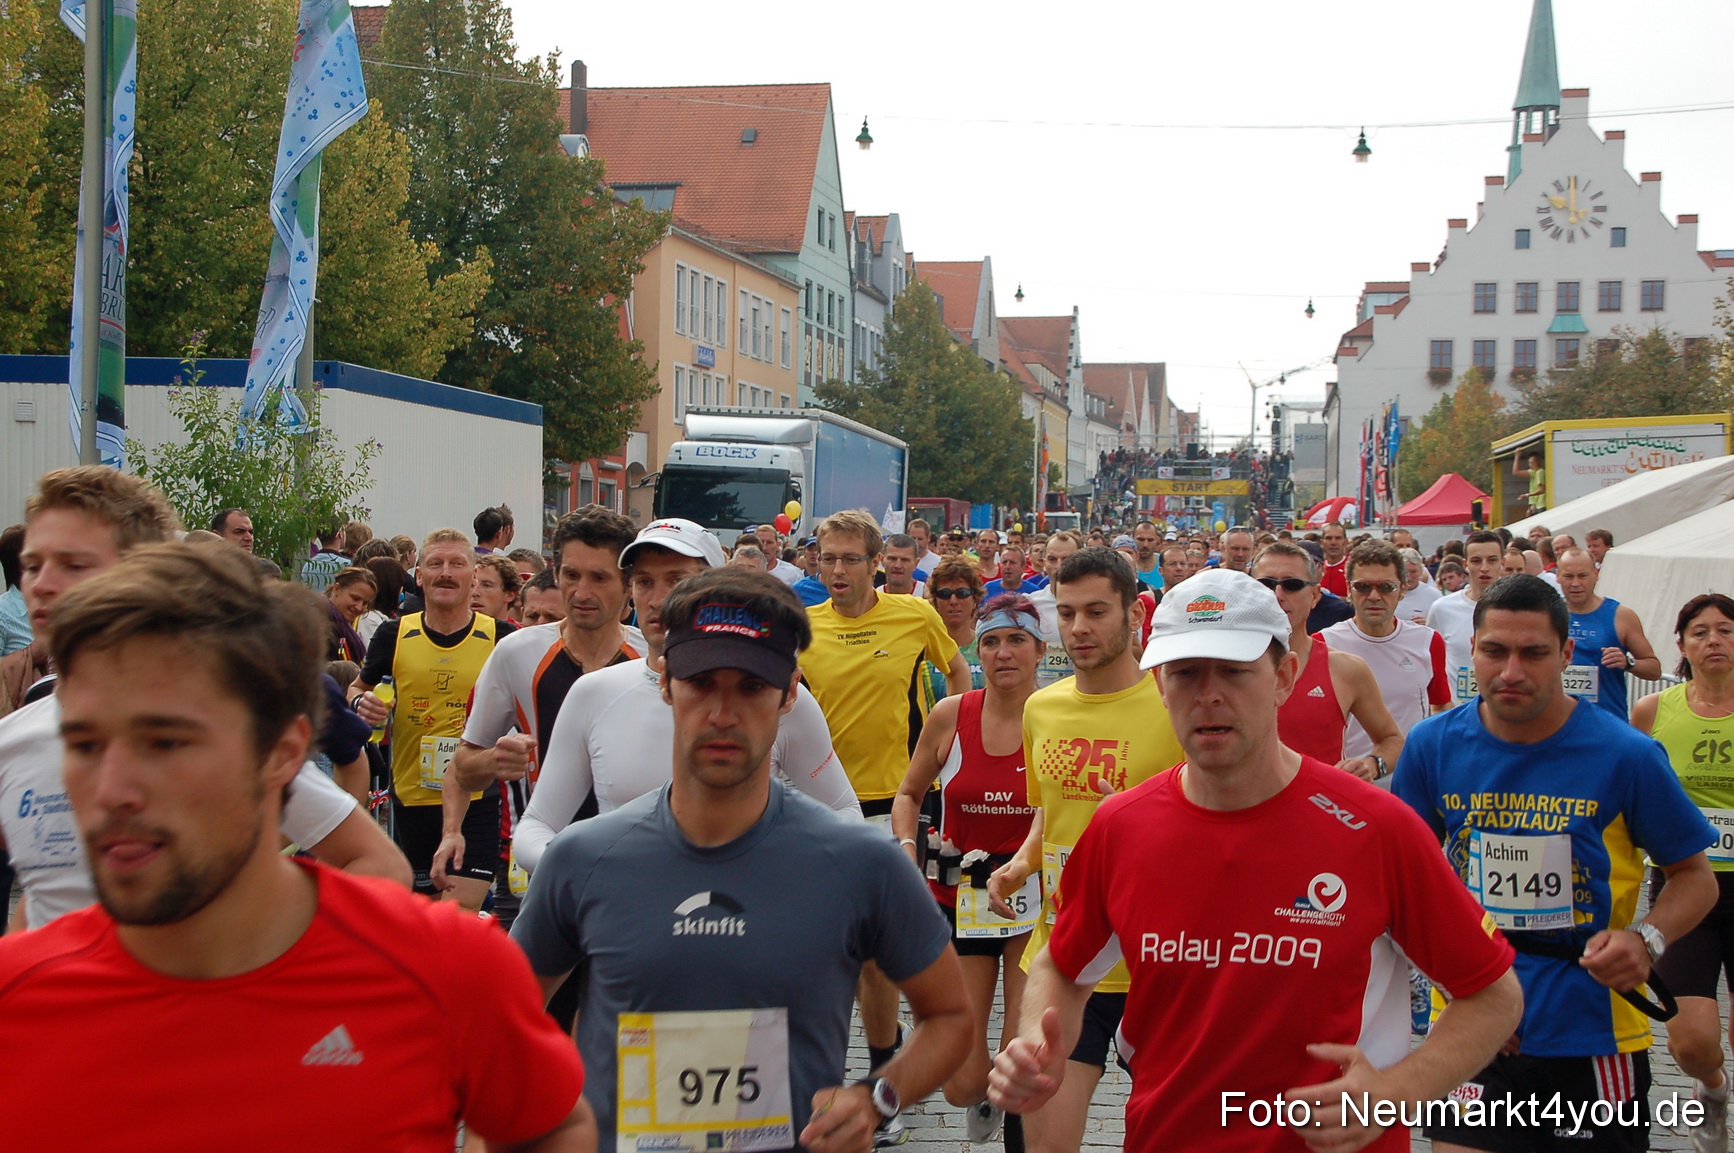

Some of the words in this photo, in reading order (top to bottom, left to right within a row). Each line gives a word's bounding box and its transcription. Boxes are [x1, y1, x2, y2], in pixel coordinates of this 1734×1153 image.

[697, 446, 757, 459] BOCK
[1172, 483, 1211, 492] START
[704, 624, 758, 638] FRANCE
[1048, 656, 1072, 666] 294
[1563, 679, 1593, 690] 3272
[422, 756, 427, 764] A
[18, 788, 38, 818] 6.
[984, 791, 1014, 802] DAV
[1442, 793, 1467, 810] 10.
[1470, 792, 1599, 818] NEUMARKTER
[1307, 792, 1368, 831] 2XU
[1464, 811, 1570, 832] STADTLAUF
[1485, 841, 1529, 862] Achim
[1488, 870, 1562, 898] 2149
[1527, 912, 1572, 924] PFLEIDERER
[672, 917, 747, 937] skinfit
[1141, 930, 1221, 969] Relay
[1229, 931, 1323, 969] 2009
[679, 1065, 762, 1106] 975
[1554, 1127, 1594, 1139] adas
